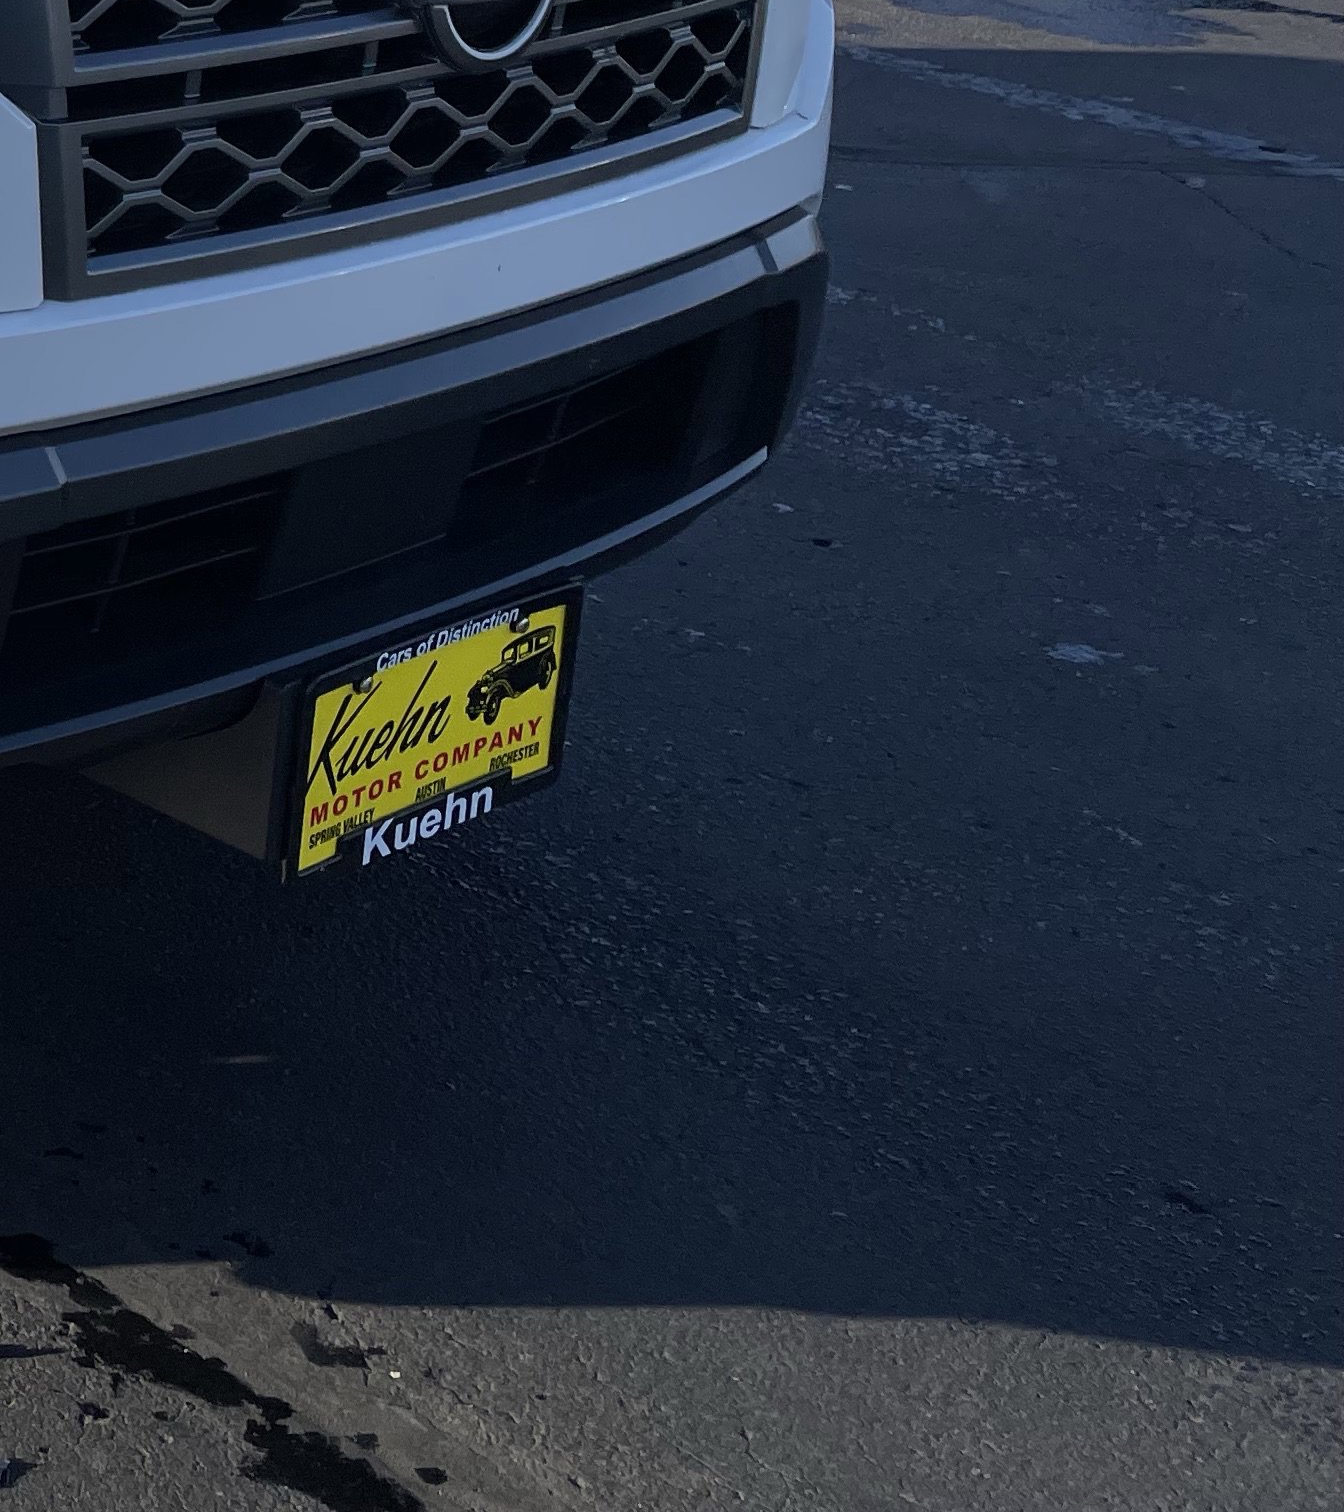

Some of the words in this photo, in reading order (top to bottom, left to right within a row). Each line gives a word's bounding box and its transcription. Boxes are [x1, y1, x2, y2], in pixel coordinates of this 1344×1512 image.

[376, 649, 412, 673] Cars
[416, 634, 437, 656] of
[436, 608, 520, 650] Distinction
[306, 659, 453, 797] Kuehn
[488, 741, 540, 772] ROCHESTER
[309, 770, 403, 828] MOTOR
[414, 716, 543, 781] COMPANY
[414, 777, 447, 803] AUSTIN
[308, 821, 341, 850] SPRING
[342, 807, 376, 836] VALLEY
[361, 786, 493, 866] Kuehn
